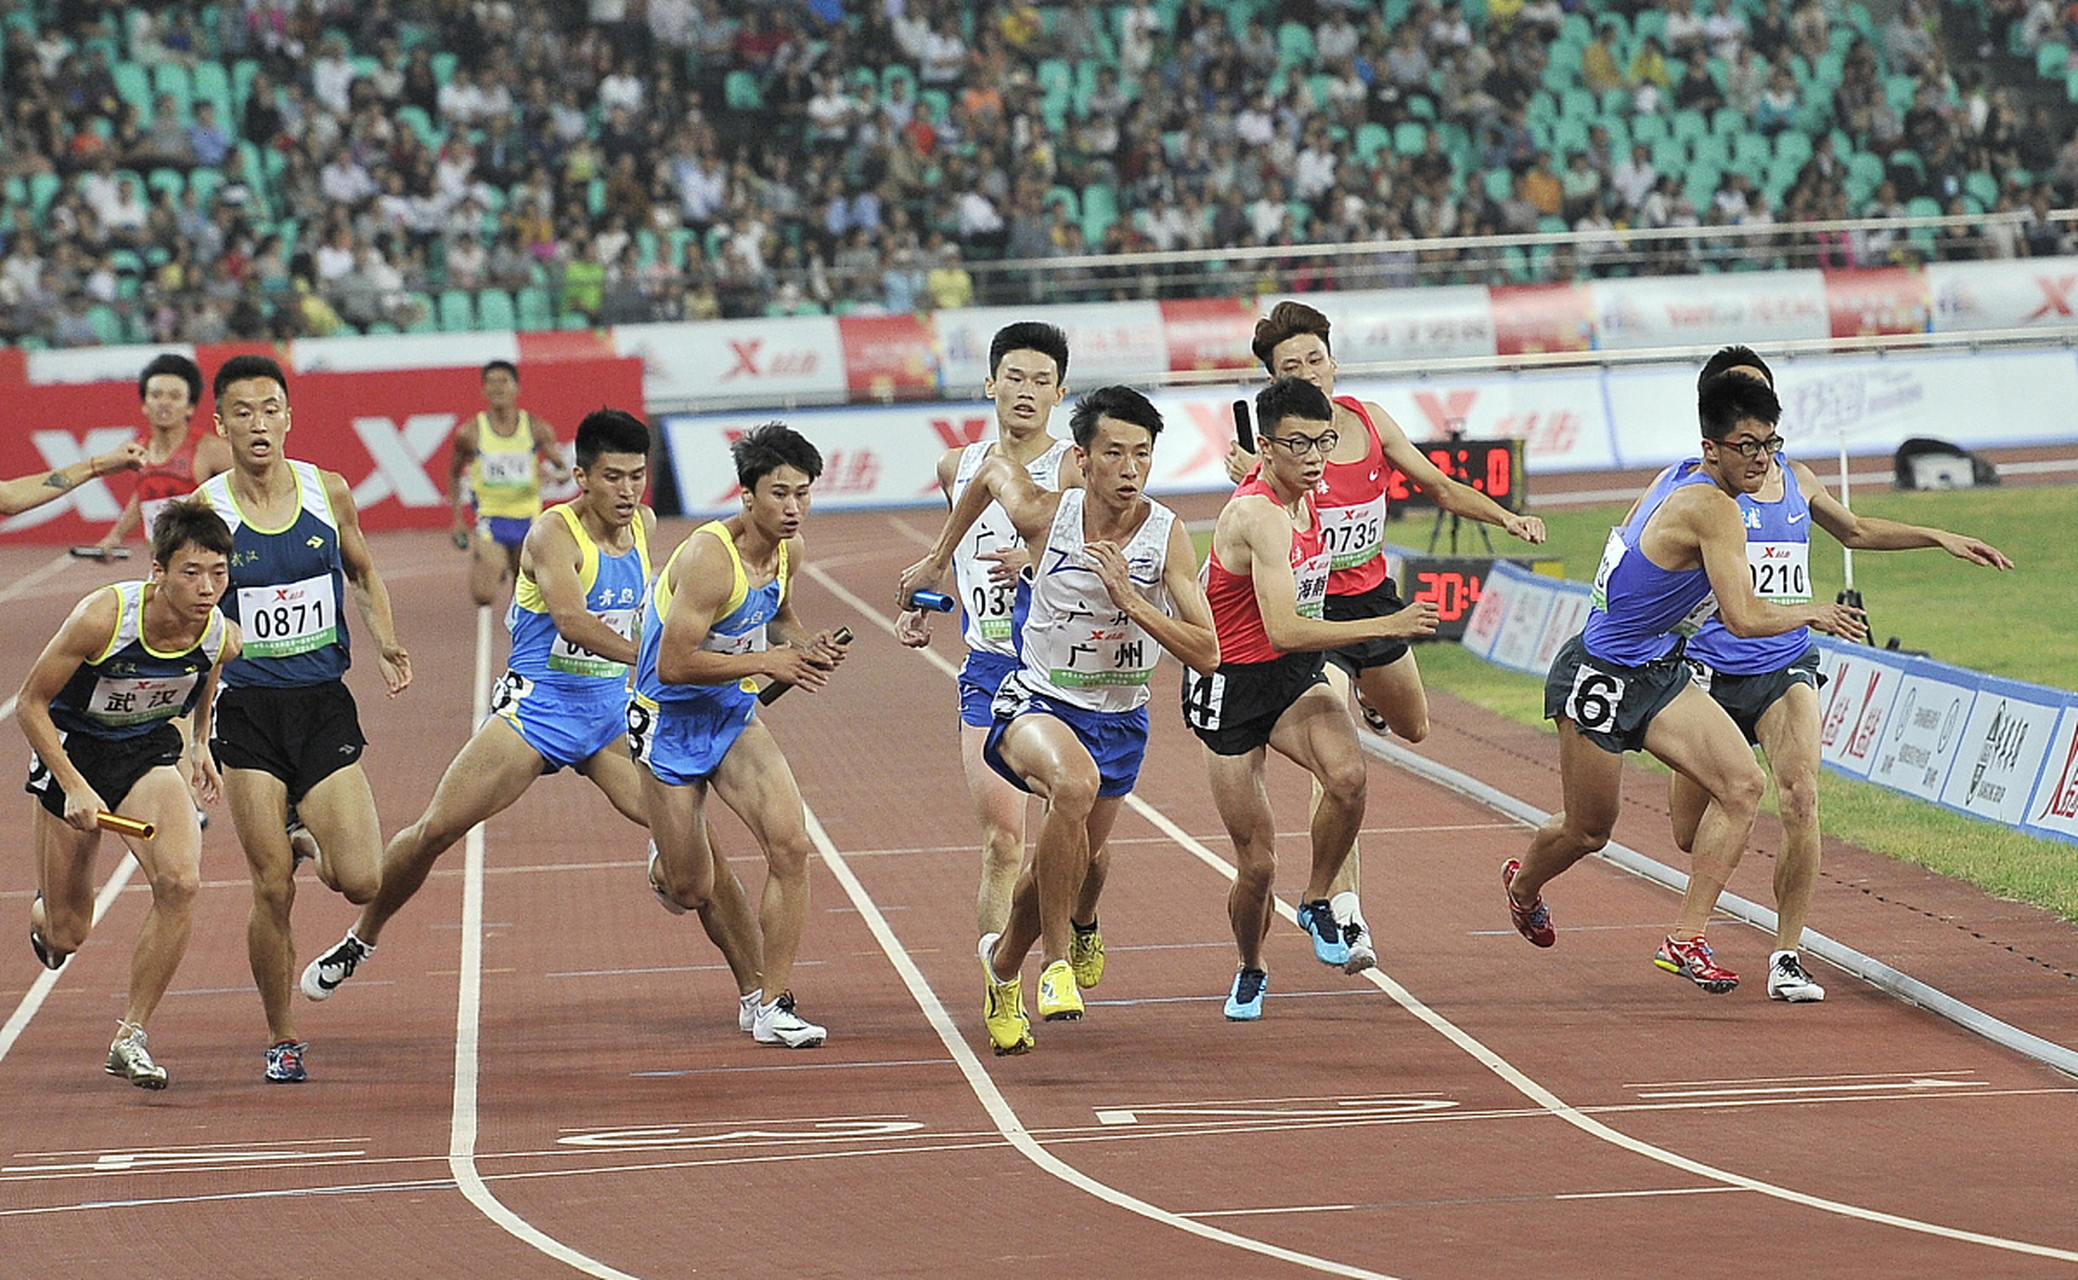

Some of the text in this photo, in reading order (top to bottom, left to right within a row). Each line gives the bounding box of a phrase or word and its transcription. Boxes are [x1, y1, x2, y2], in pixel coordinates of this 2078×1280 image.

[1323, 518, 1378, 553] 0735
[254, 600, 324, 639] 0871
[1067, 640, 1143, 668] 广州
[104, 689, 178, 713] 武汉
[1575, 674, 1617, 727] 6
